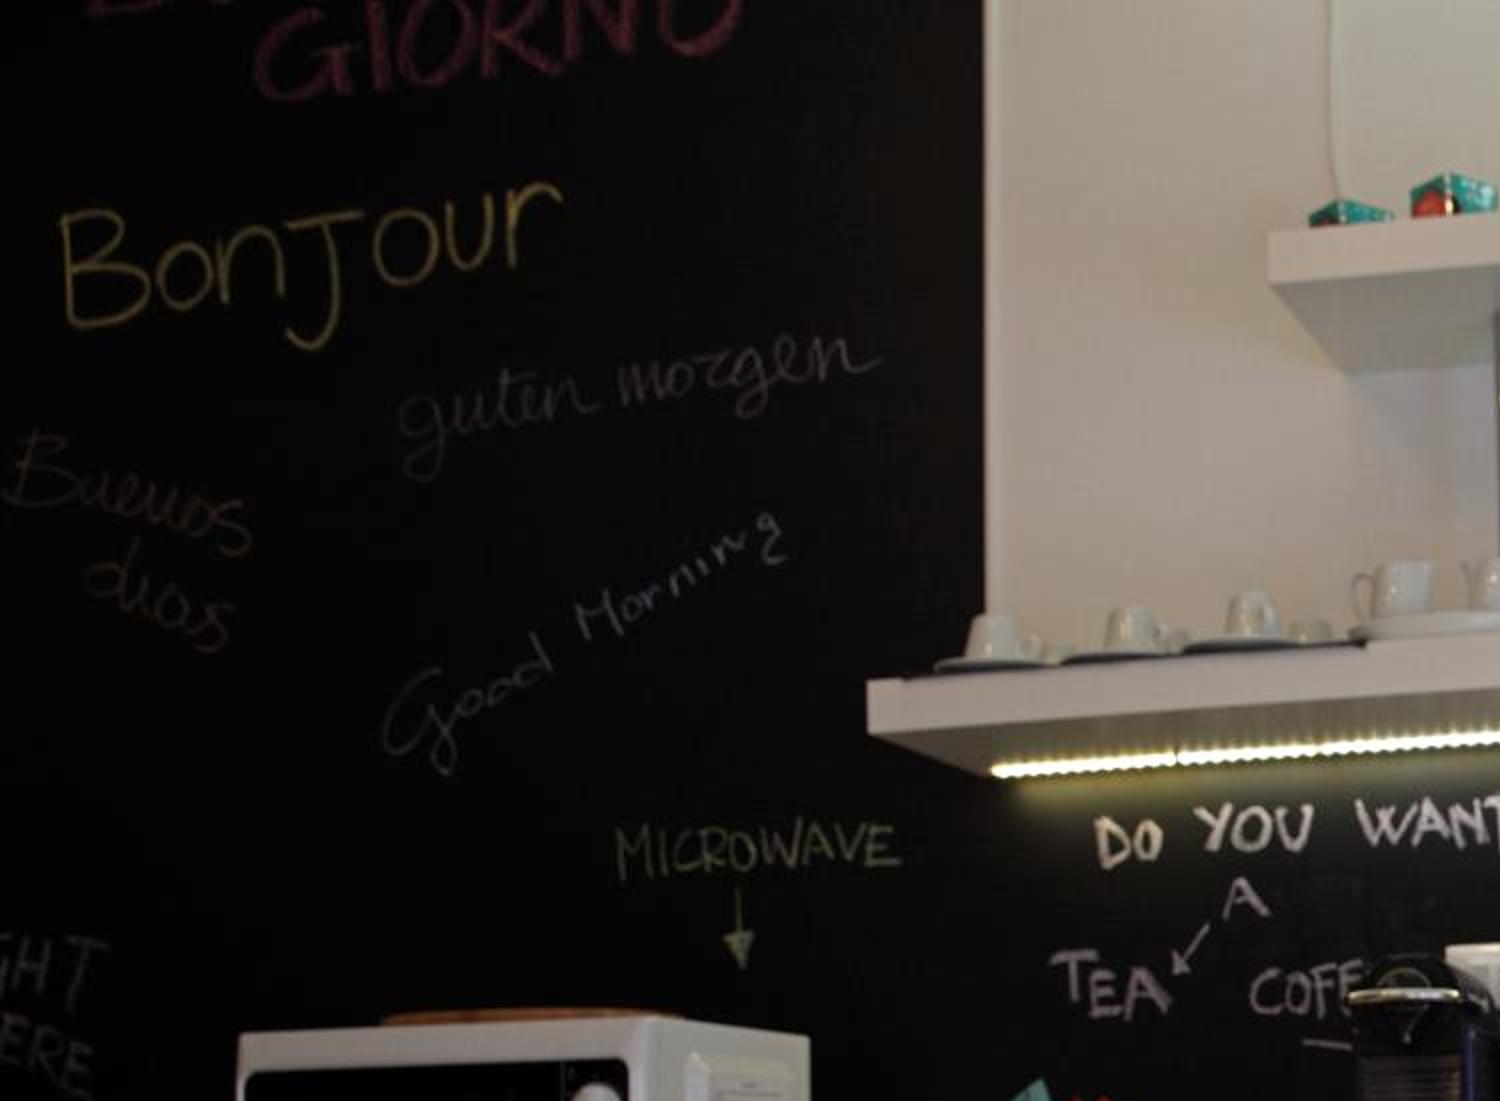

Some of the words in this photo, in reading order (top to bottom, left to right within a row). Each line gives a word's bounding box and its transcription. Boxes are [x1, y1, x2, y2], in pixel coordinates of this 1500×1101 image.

[381, 630, 556, 778] Good
[614, 818, 904, 881] MICROWAVE
[1094, 814, 1164, 869] DO
[1194, 801, 1314, 852] YOU
[1221, 876, 1272, 920] A
[1049, 948, 1174, 1021] TEA
